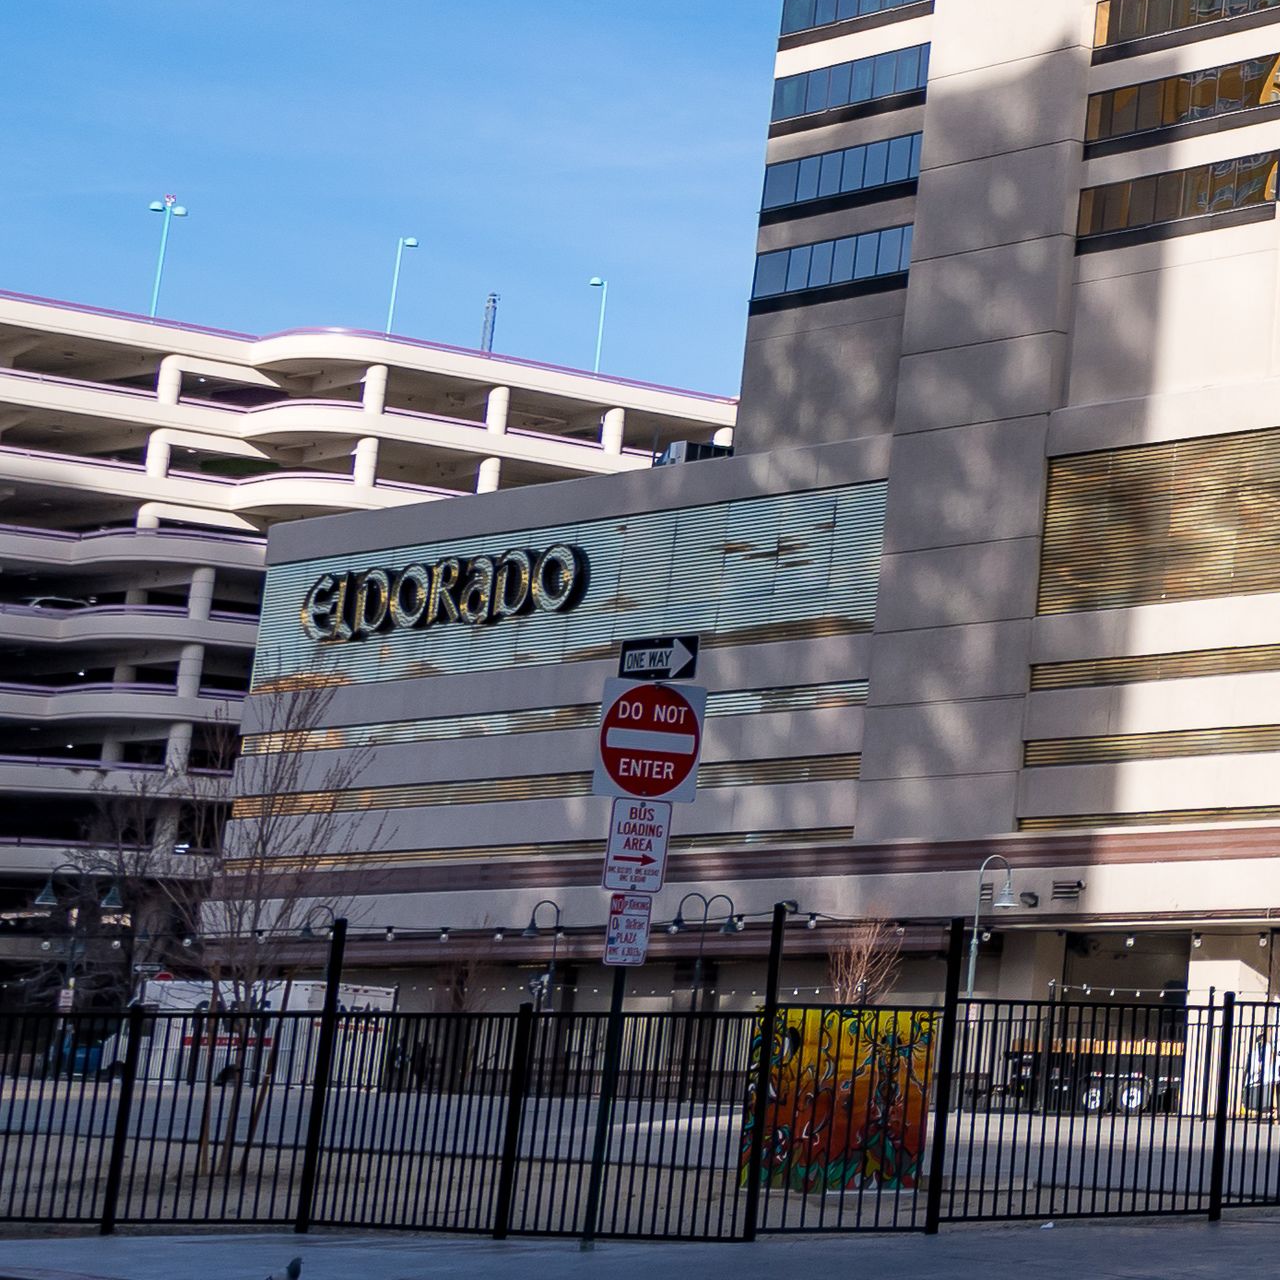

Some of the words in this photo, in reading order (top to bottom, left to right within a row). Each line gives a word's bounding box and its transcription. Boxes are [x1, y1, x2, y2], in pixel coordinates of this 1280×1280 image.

[301, 543, 578, 642] ELDORADO
[626, 652, 646, 669] ONE
[648, 650, 672, 668] WAY
[618, 701, 643, 720] DO
[653, 704, 688, 724] NOT
[619, 758, 675, 780] ENTER
[629, 806, 655, 821] BUS
[617, 821, 663, 838] LOADING
[623, 836, 653, 852] AREA
